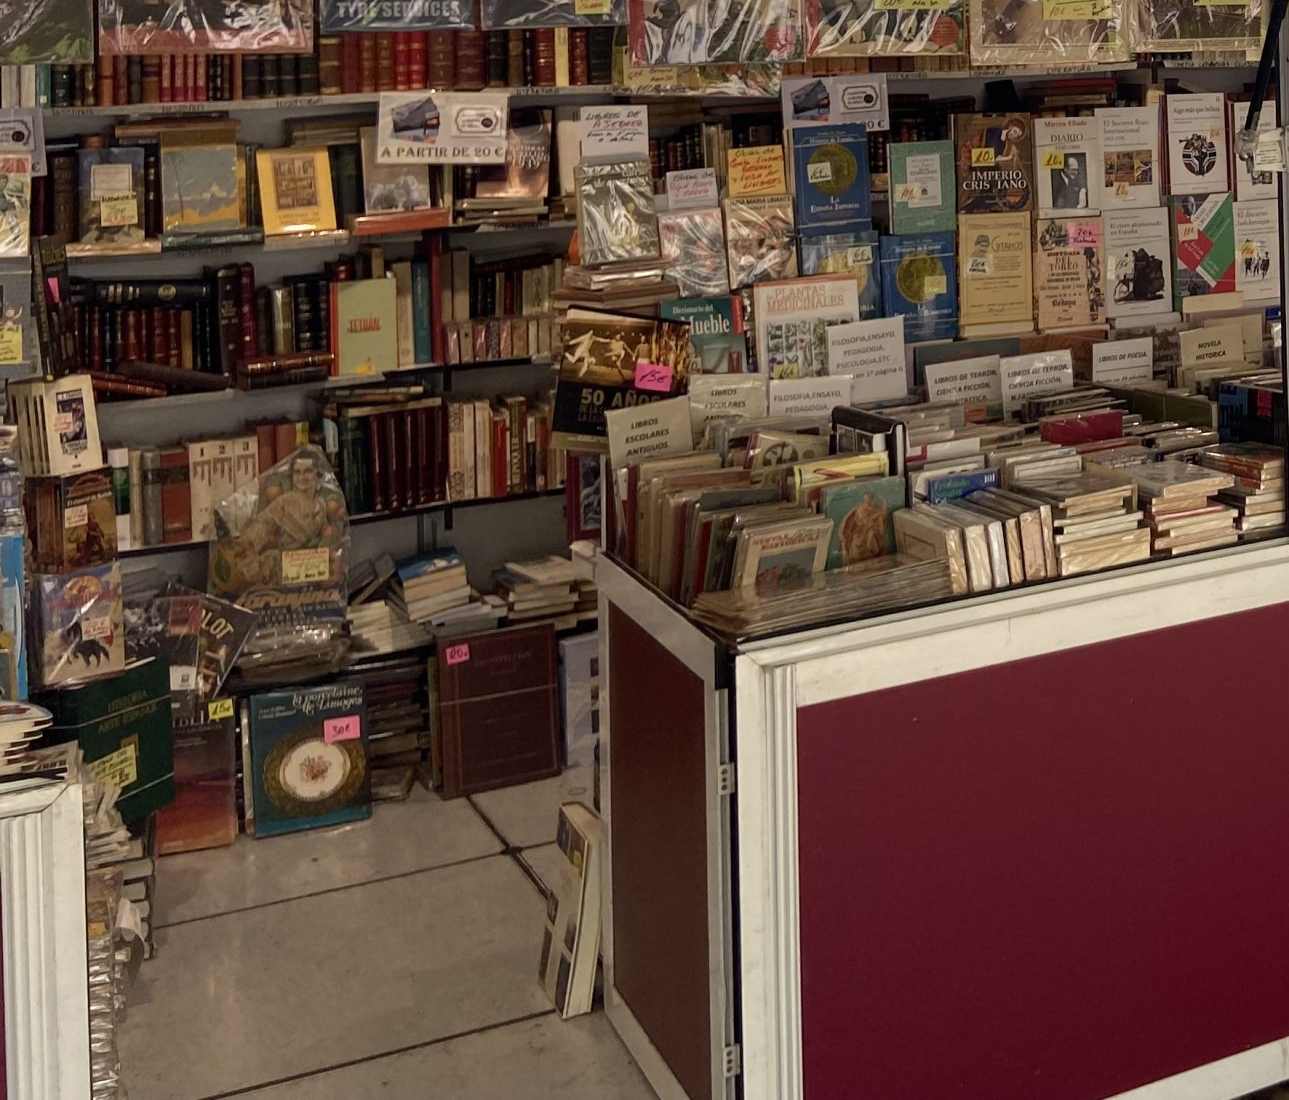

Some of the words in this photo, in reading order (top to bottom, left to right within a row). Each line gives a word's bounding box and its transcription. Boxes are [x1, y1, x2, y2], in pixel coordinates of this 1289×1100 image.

[1068, 119, 1088, 127] Eliade
[1050, 133, 1084, 143] DIARIO
[380, 147, 392, 158] A
[396, 146, 448, 158] PARTIR
[452, 146, 470, 158] DE
[474, 146, 491, 157] 20
[494, 146, 504, 157] €
[971, 170, 1022, 181] IMPERIO
[962, 178, 1027, 191] CRISIANO
[774, 284, 827, 299] PLANTAS
[672, 306, 704, 315] Diccionario
[704, 304, 714, 313] del
[767, 293, 845, 315] MEDICINALES
[680, 314, 731, 336] Mueble
[1198, 339, 1222, 350] NOVELA
[1098, 354, 1118, 363] LIBROS
[1118, 353, 1127, 361] DE
[934, 374, 959, 384] LIBROS
[959, 373, 969, 381] DE
[970, 369, 998, 381] TERROR,
[1007, 368, 1031, 378] LIBROS
[1031, 367, 1041, 375] DE
[580, 388, 604, 406] 50
[710, 387, 738, 397] LIBROS
[630, 417, 659, 430] LIBROS
[625, 428, 670, 445] ESCOLARES
[199, 447, 205, 457] 1
[218, 444, 226, 454] 2
[242, 441, 249, 451] 3
[292, 692, 303, 707] la
[304, 686, 363, 703] porcelaine
[318, 696, 363, 711] Limoges
